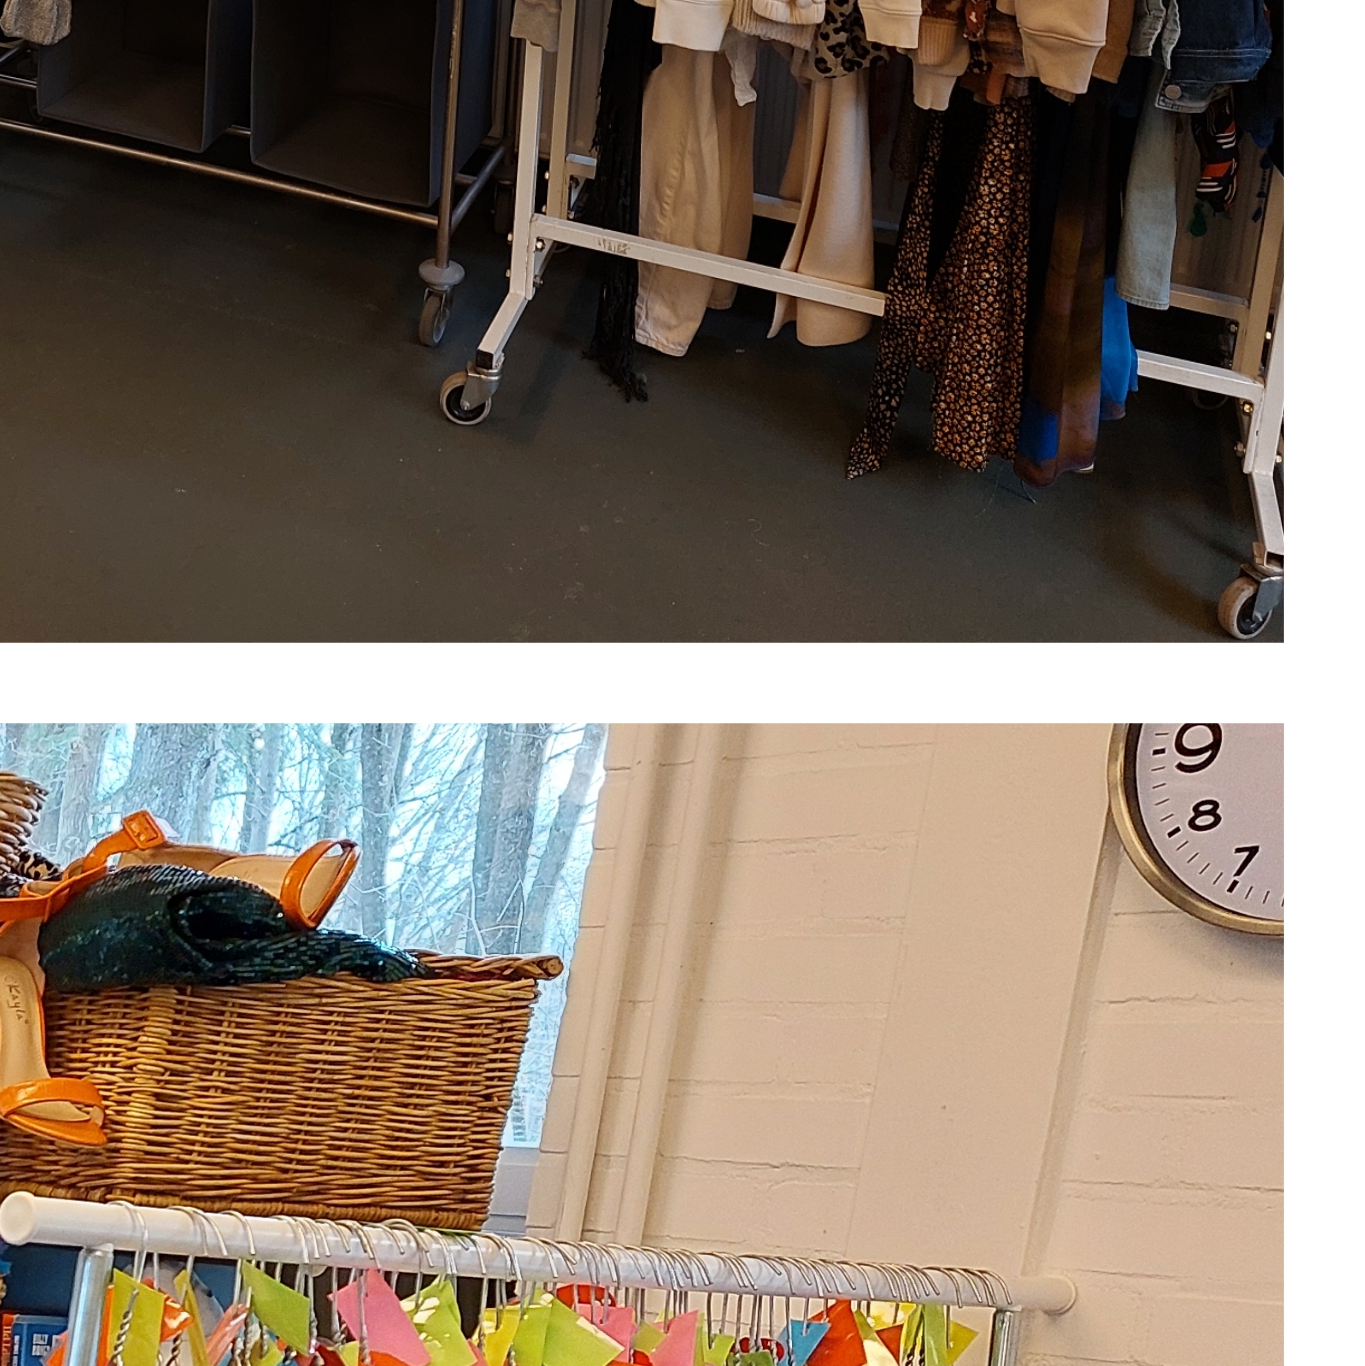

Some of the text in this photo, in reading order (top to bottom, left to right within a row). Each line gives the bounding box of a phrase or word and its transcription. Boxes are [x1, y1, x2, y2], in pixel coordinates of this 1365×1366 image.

[1174, 723, 1223, 773] 9
[1188, 799, 1223, 832] 8
[1232, 844, 1261, 877] 7
